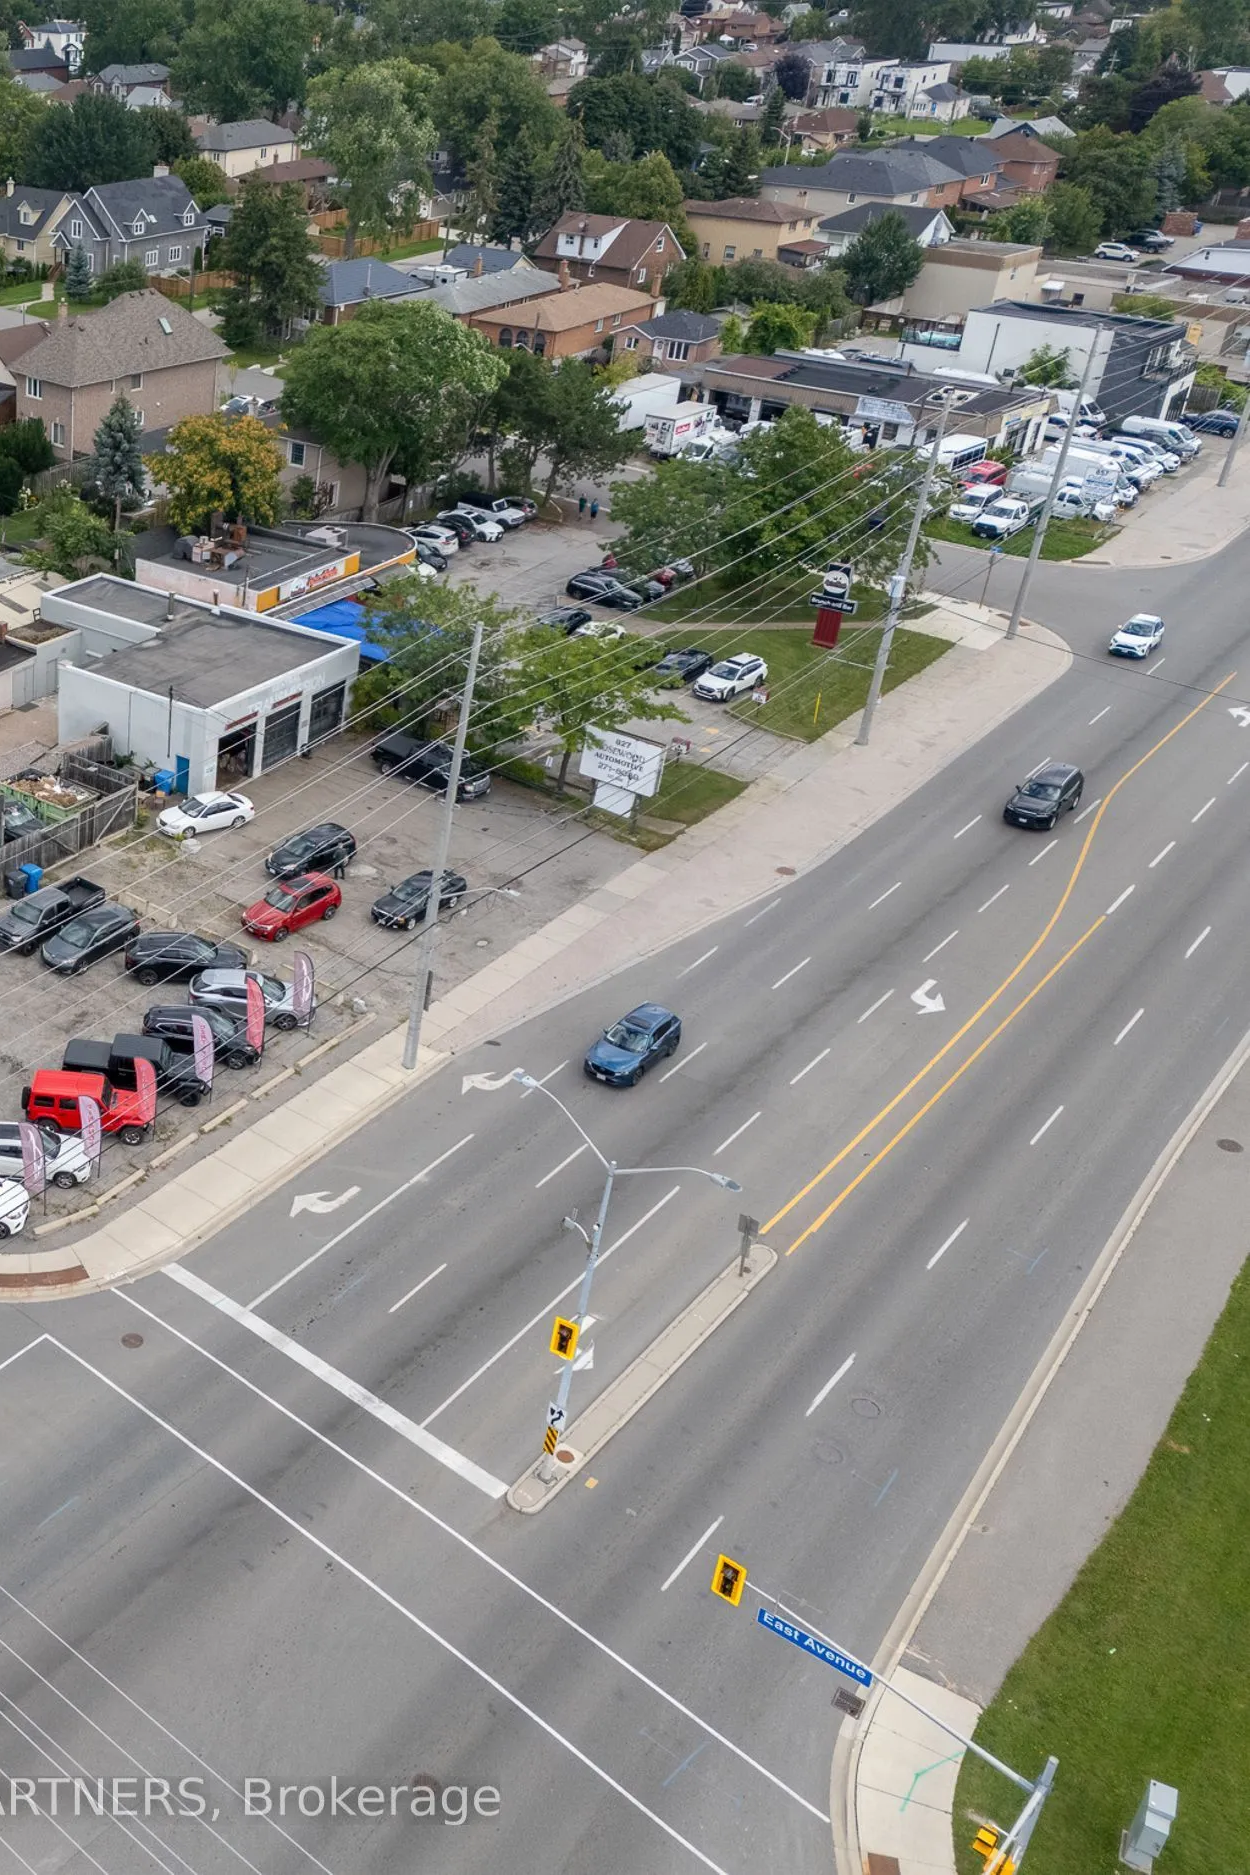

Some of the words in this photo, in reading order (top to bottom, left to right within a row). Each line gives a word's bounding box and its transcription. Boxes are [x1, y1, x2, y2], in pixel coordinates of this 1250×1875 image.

[594, 752, 644, 772] AUTOMOTIVE
[763, 1612, 800, 1641] East
[803, 1639, 868, 1679] Avenue
